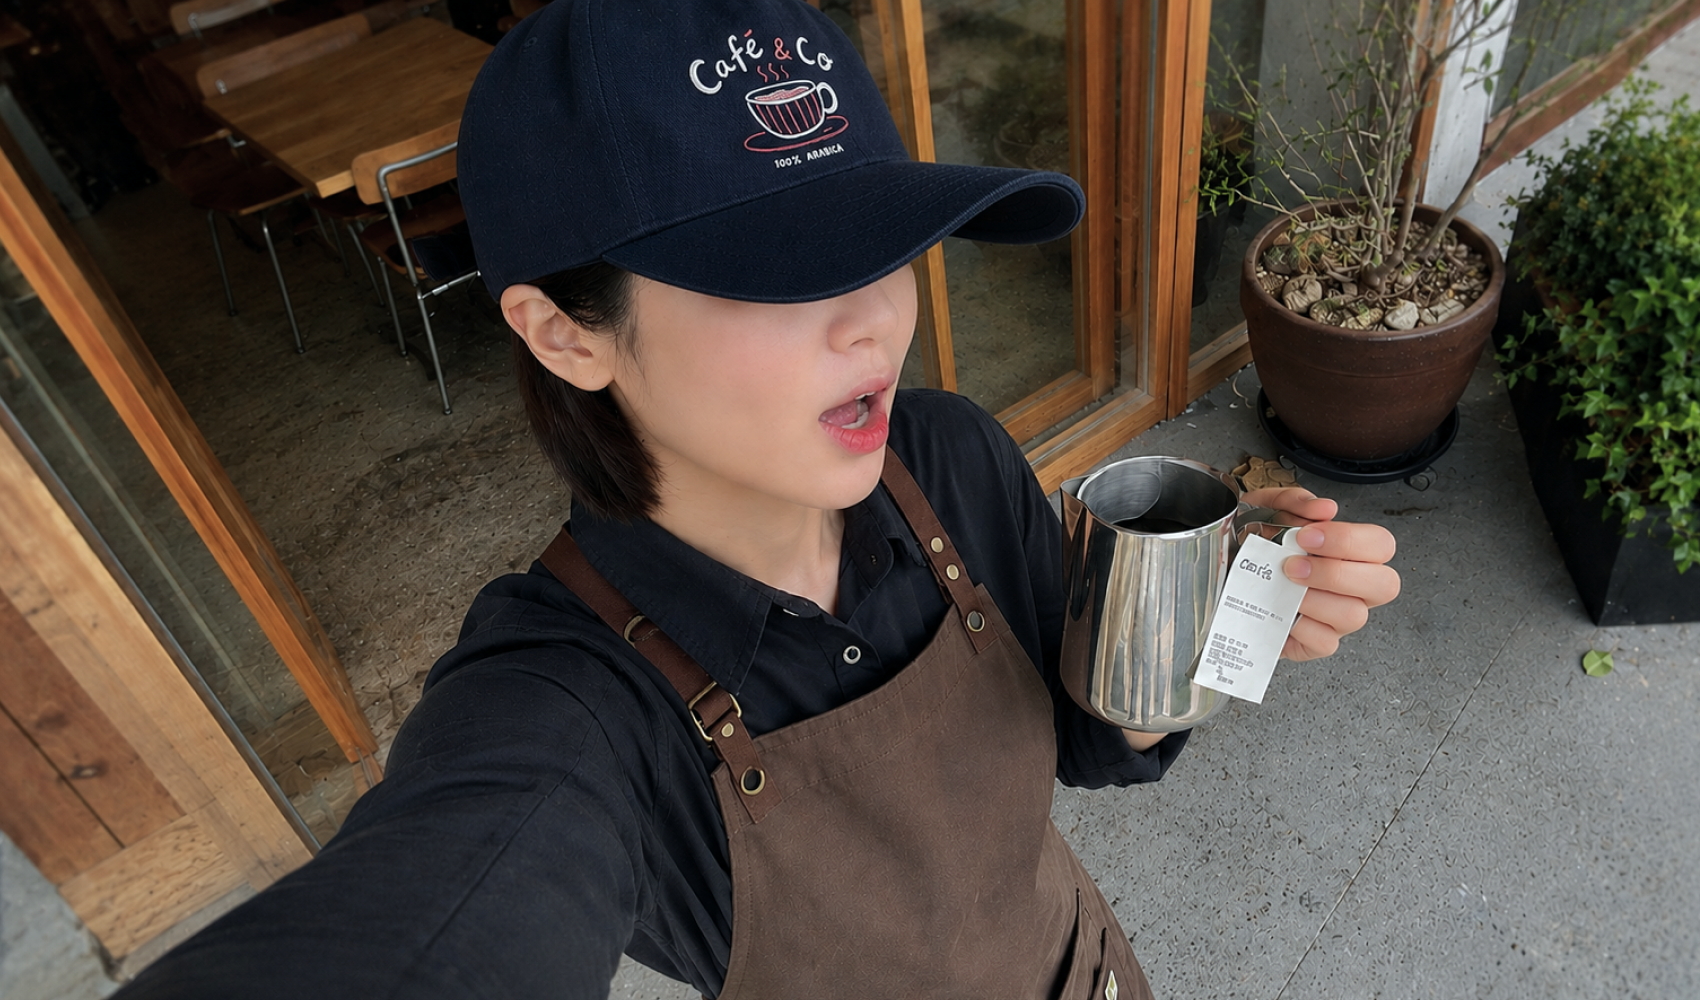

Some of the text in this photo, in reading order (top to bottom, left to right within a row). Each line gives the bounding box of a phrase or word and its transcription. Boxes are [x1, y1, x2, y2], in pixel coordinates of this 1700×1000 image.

[689, 29, 834, 95] Café & Co
[774, 143, 845, 169] 100% ARABICA
